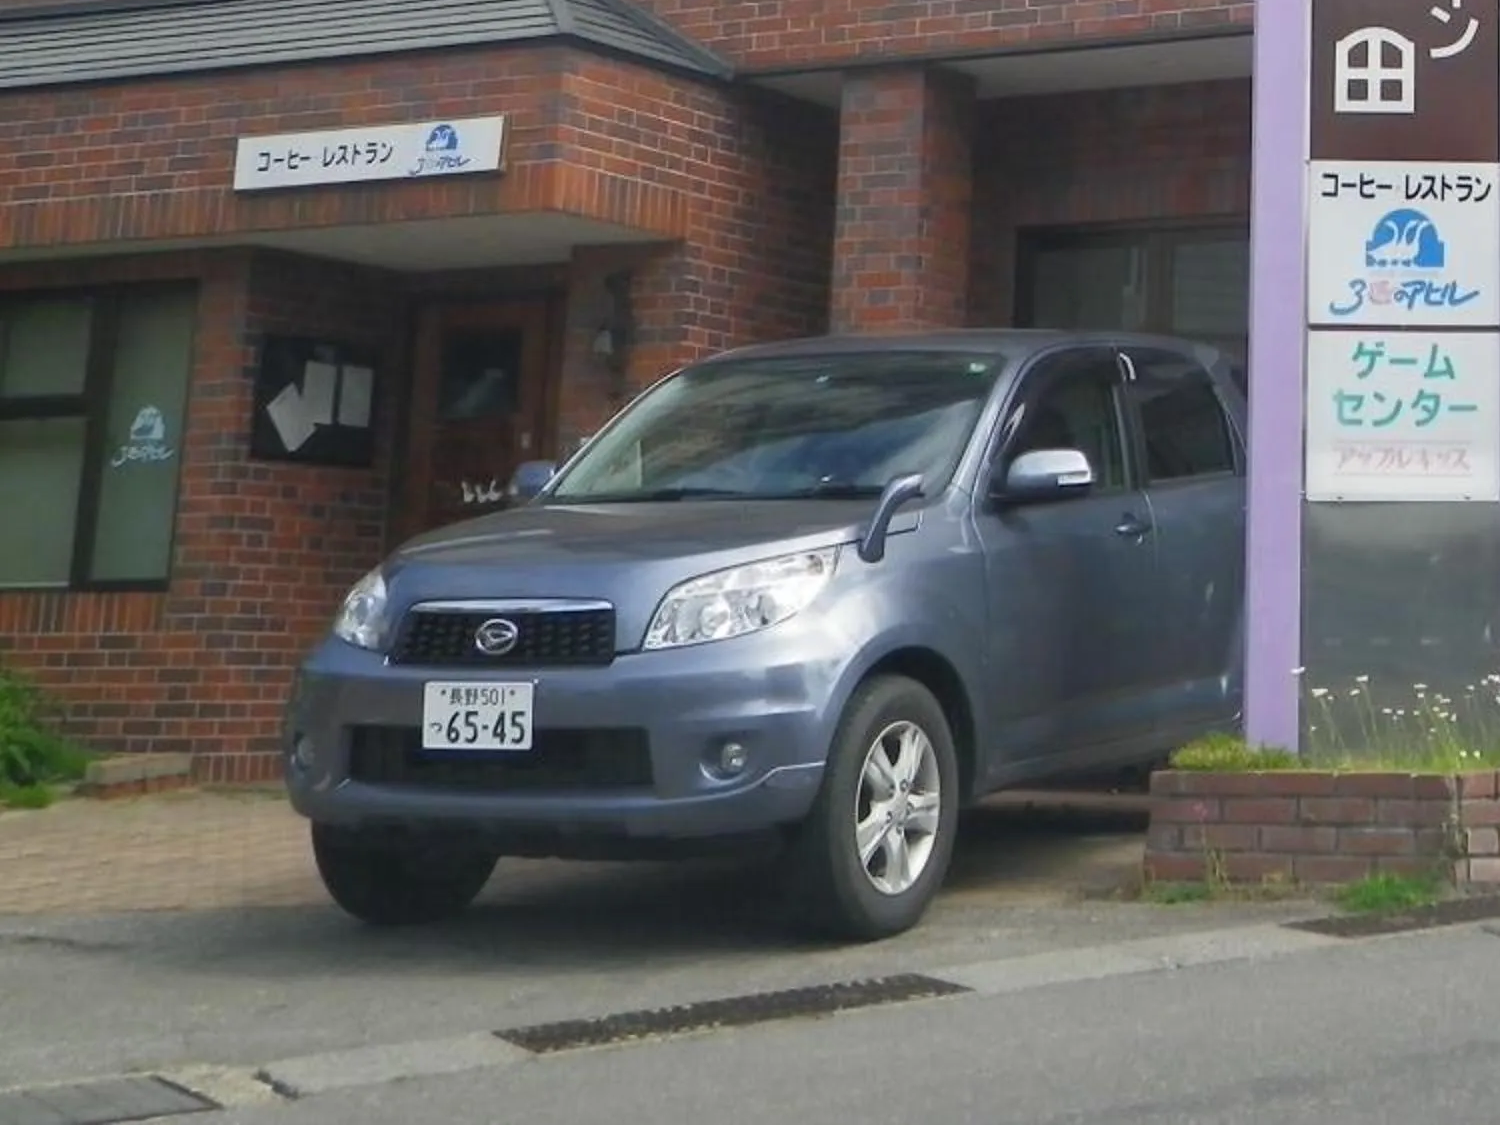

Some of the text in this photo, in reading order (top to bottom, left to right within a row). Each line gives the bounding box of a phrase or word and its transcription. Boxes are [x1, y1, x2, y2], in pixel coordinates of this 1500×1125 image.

[257, 142, 393, 172] コーヒー レストラン
[1321, 173, 1491, 202] コーヒー レストラン
[1351, 341, 1456, 380] ゲーム
[1332, 389, 1478, 428] センター
[446, 710, 526, 744] 65-45
